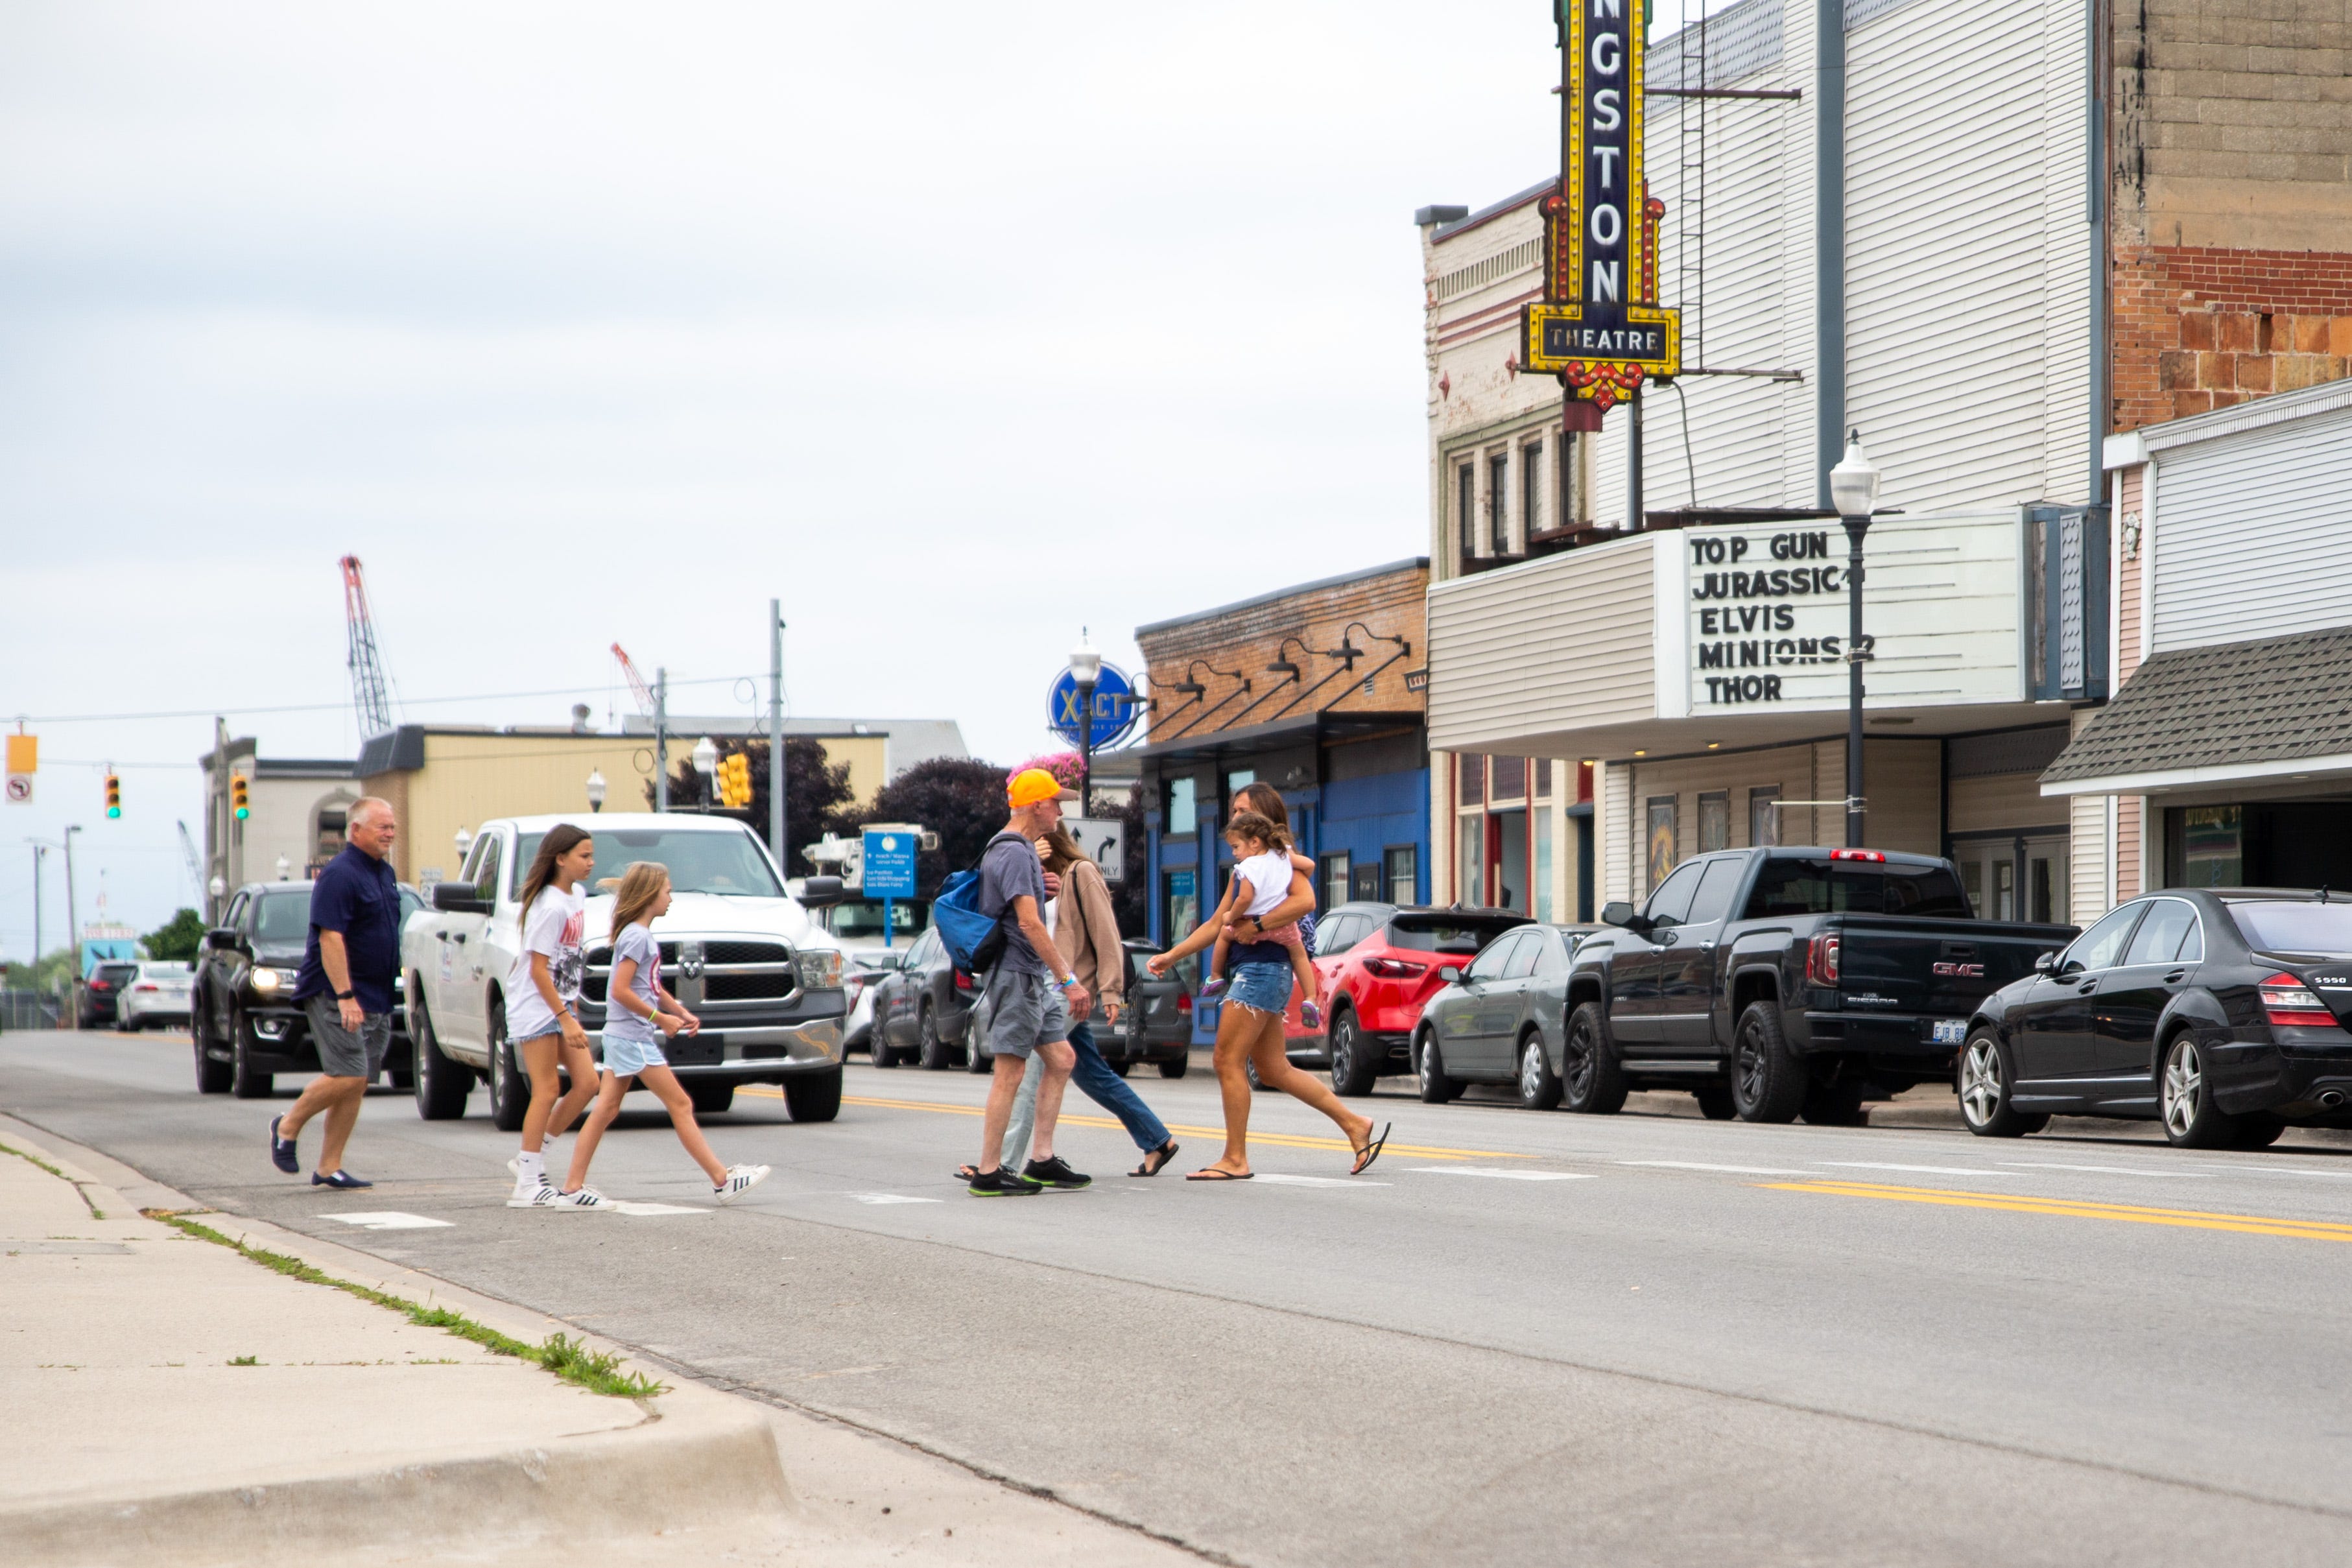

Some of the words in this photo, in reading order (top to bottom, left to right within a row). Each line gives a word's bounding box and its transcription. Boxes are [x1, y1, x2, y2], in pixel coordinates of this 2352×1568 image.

[1550, 328, 1658, 351] THEATRE
[1690, 536, 1748, 565] TOP
[1770, 531, 1827, 560] GUN
[1693, 565, 1840, 599] JURASSIC
[1701, 604, 1794, 634] ELVIS
[1698, 636, 1840, 669] MINIONS
[1705, 674, 1782, 704] THOR
[1100, 866, 1118, 875] NLY
[1933, 962, 1984, 977] GMC
